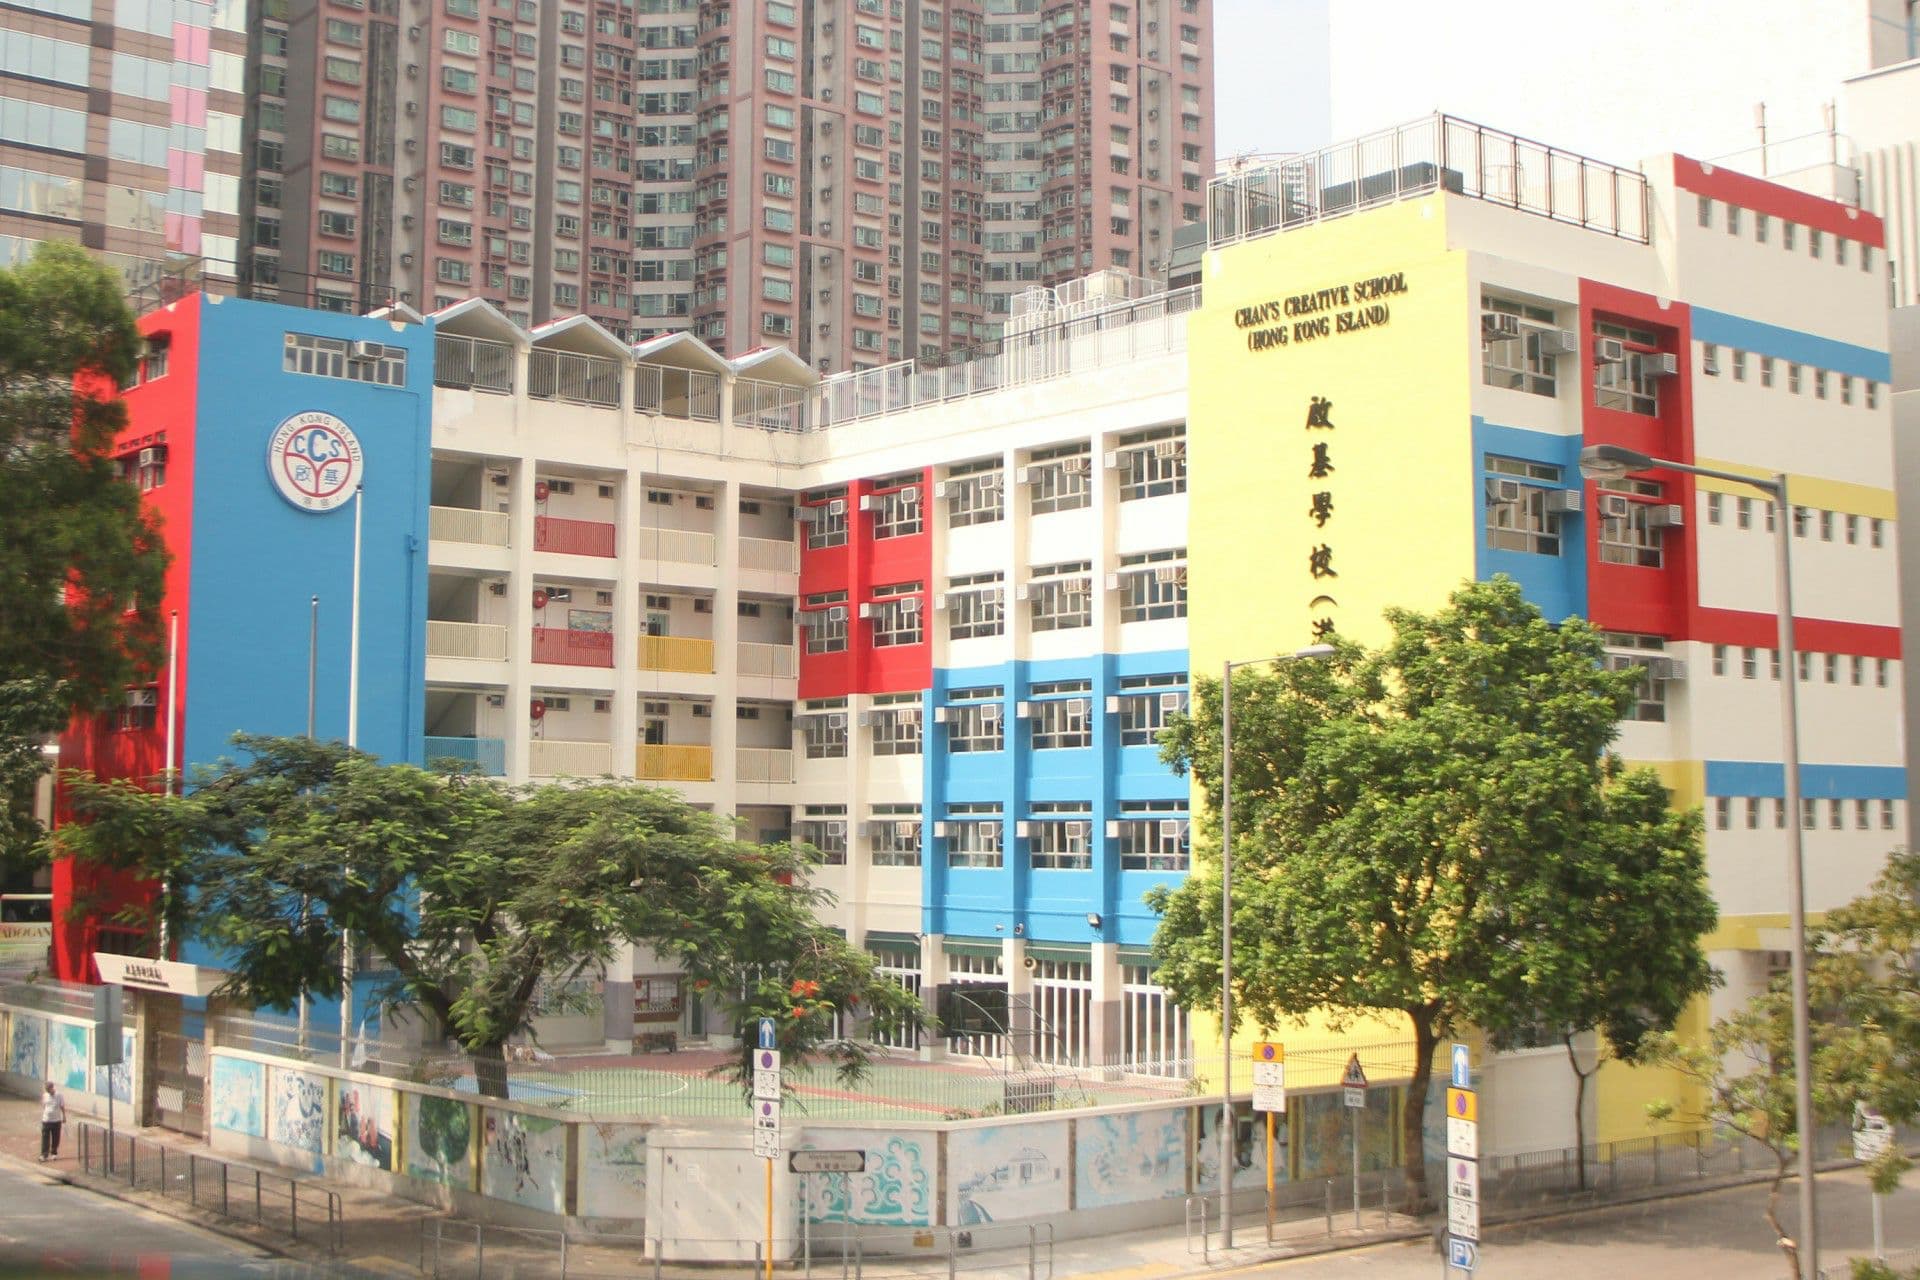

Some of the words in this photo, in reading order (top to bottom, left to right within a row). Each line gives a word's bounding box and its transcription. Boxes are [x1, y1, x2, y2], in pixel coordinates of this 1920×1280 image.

[1235, 301, 1280, 329] CHAN'S
[1284, 285, 1349, 316] CREATIVE
[1354, 272, 1408, 300] SCHOOL
[1248, 324, 1289, 352] (HONG
[1294, 316, 1329, 343] KONG
[1336, 303, 1390, 333] ISLAND)
[299, 414, 331, 425] KONG
[293, 429, 341, 462] CCS
